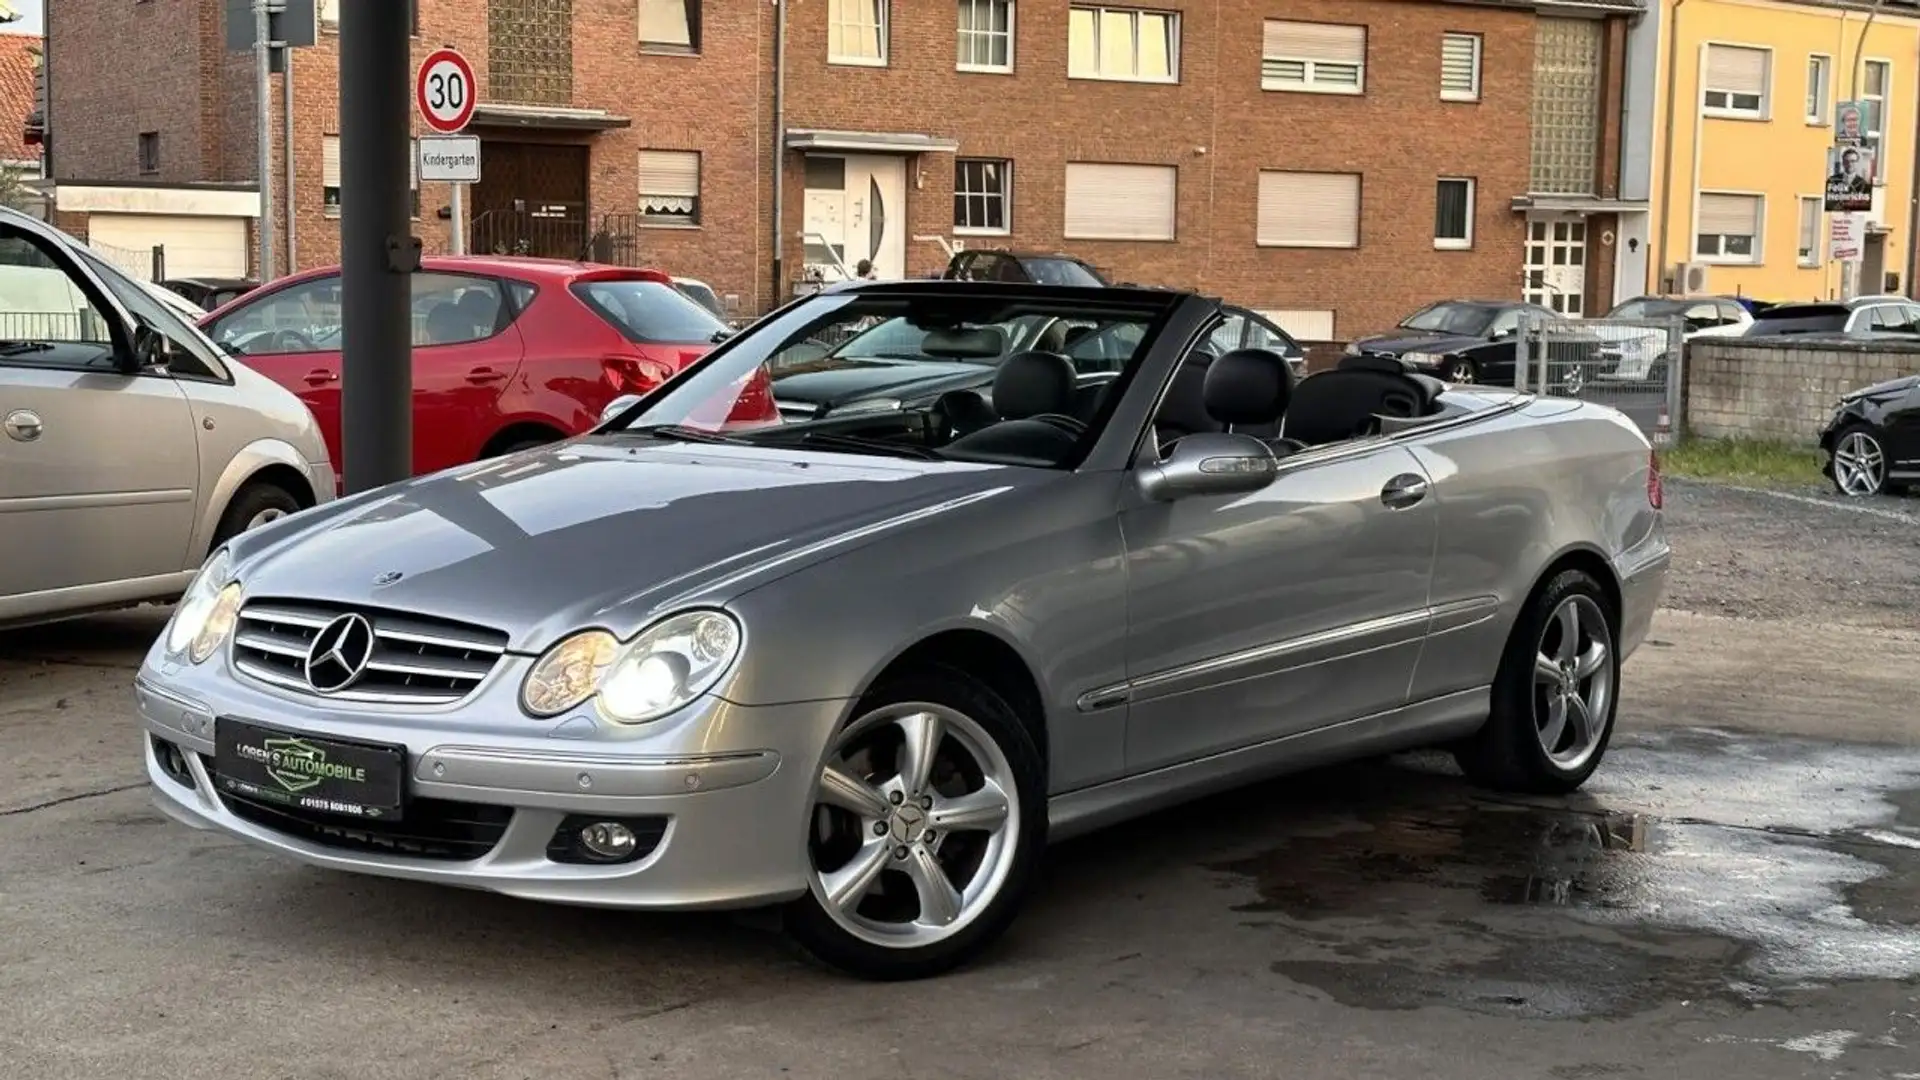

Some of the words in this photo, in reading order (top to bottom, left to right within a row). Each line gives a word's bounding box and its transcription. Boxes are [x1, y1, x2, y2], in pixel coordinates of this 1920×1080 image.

[430, 73, 463, 109] 30
[423, 153, 475, 169] Kindergarten
[282, 755, 366, 782] AUTOMOBILE
